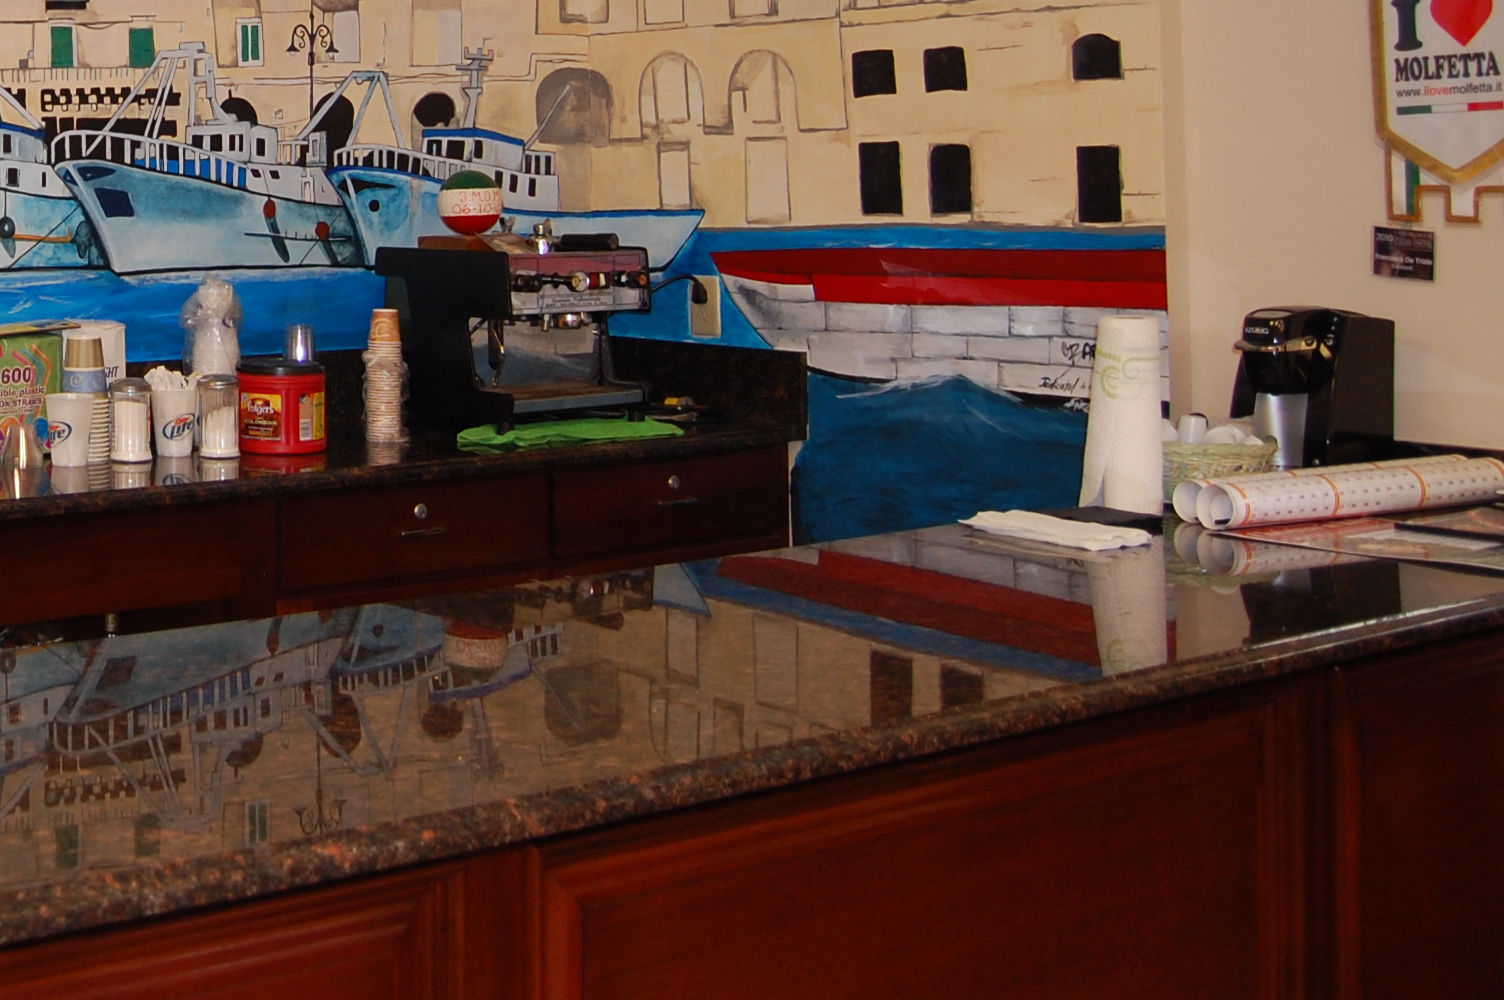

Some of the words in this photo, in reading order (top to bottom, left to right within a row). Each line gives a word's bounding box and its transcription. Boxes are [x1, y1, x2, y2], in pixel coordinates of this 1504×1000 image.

[1394, 51, 1501, 82] MOLFETTA
[1396, 82, 1502, 97] www.ilovemolfetta.it
[1, 367, 32, 385] 600
[18, 385, 46, 397] plastic
